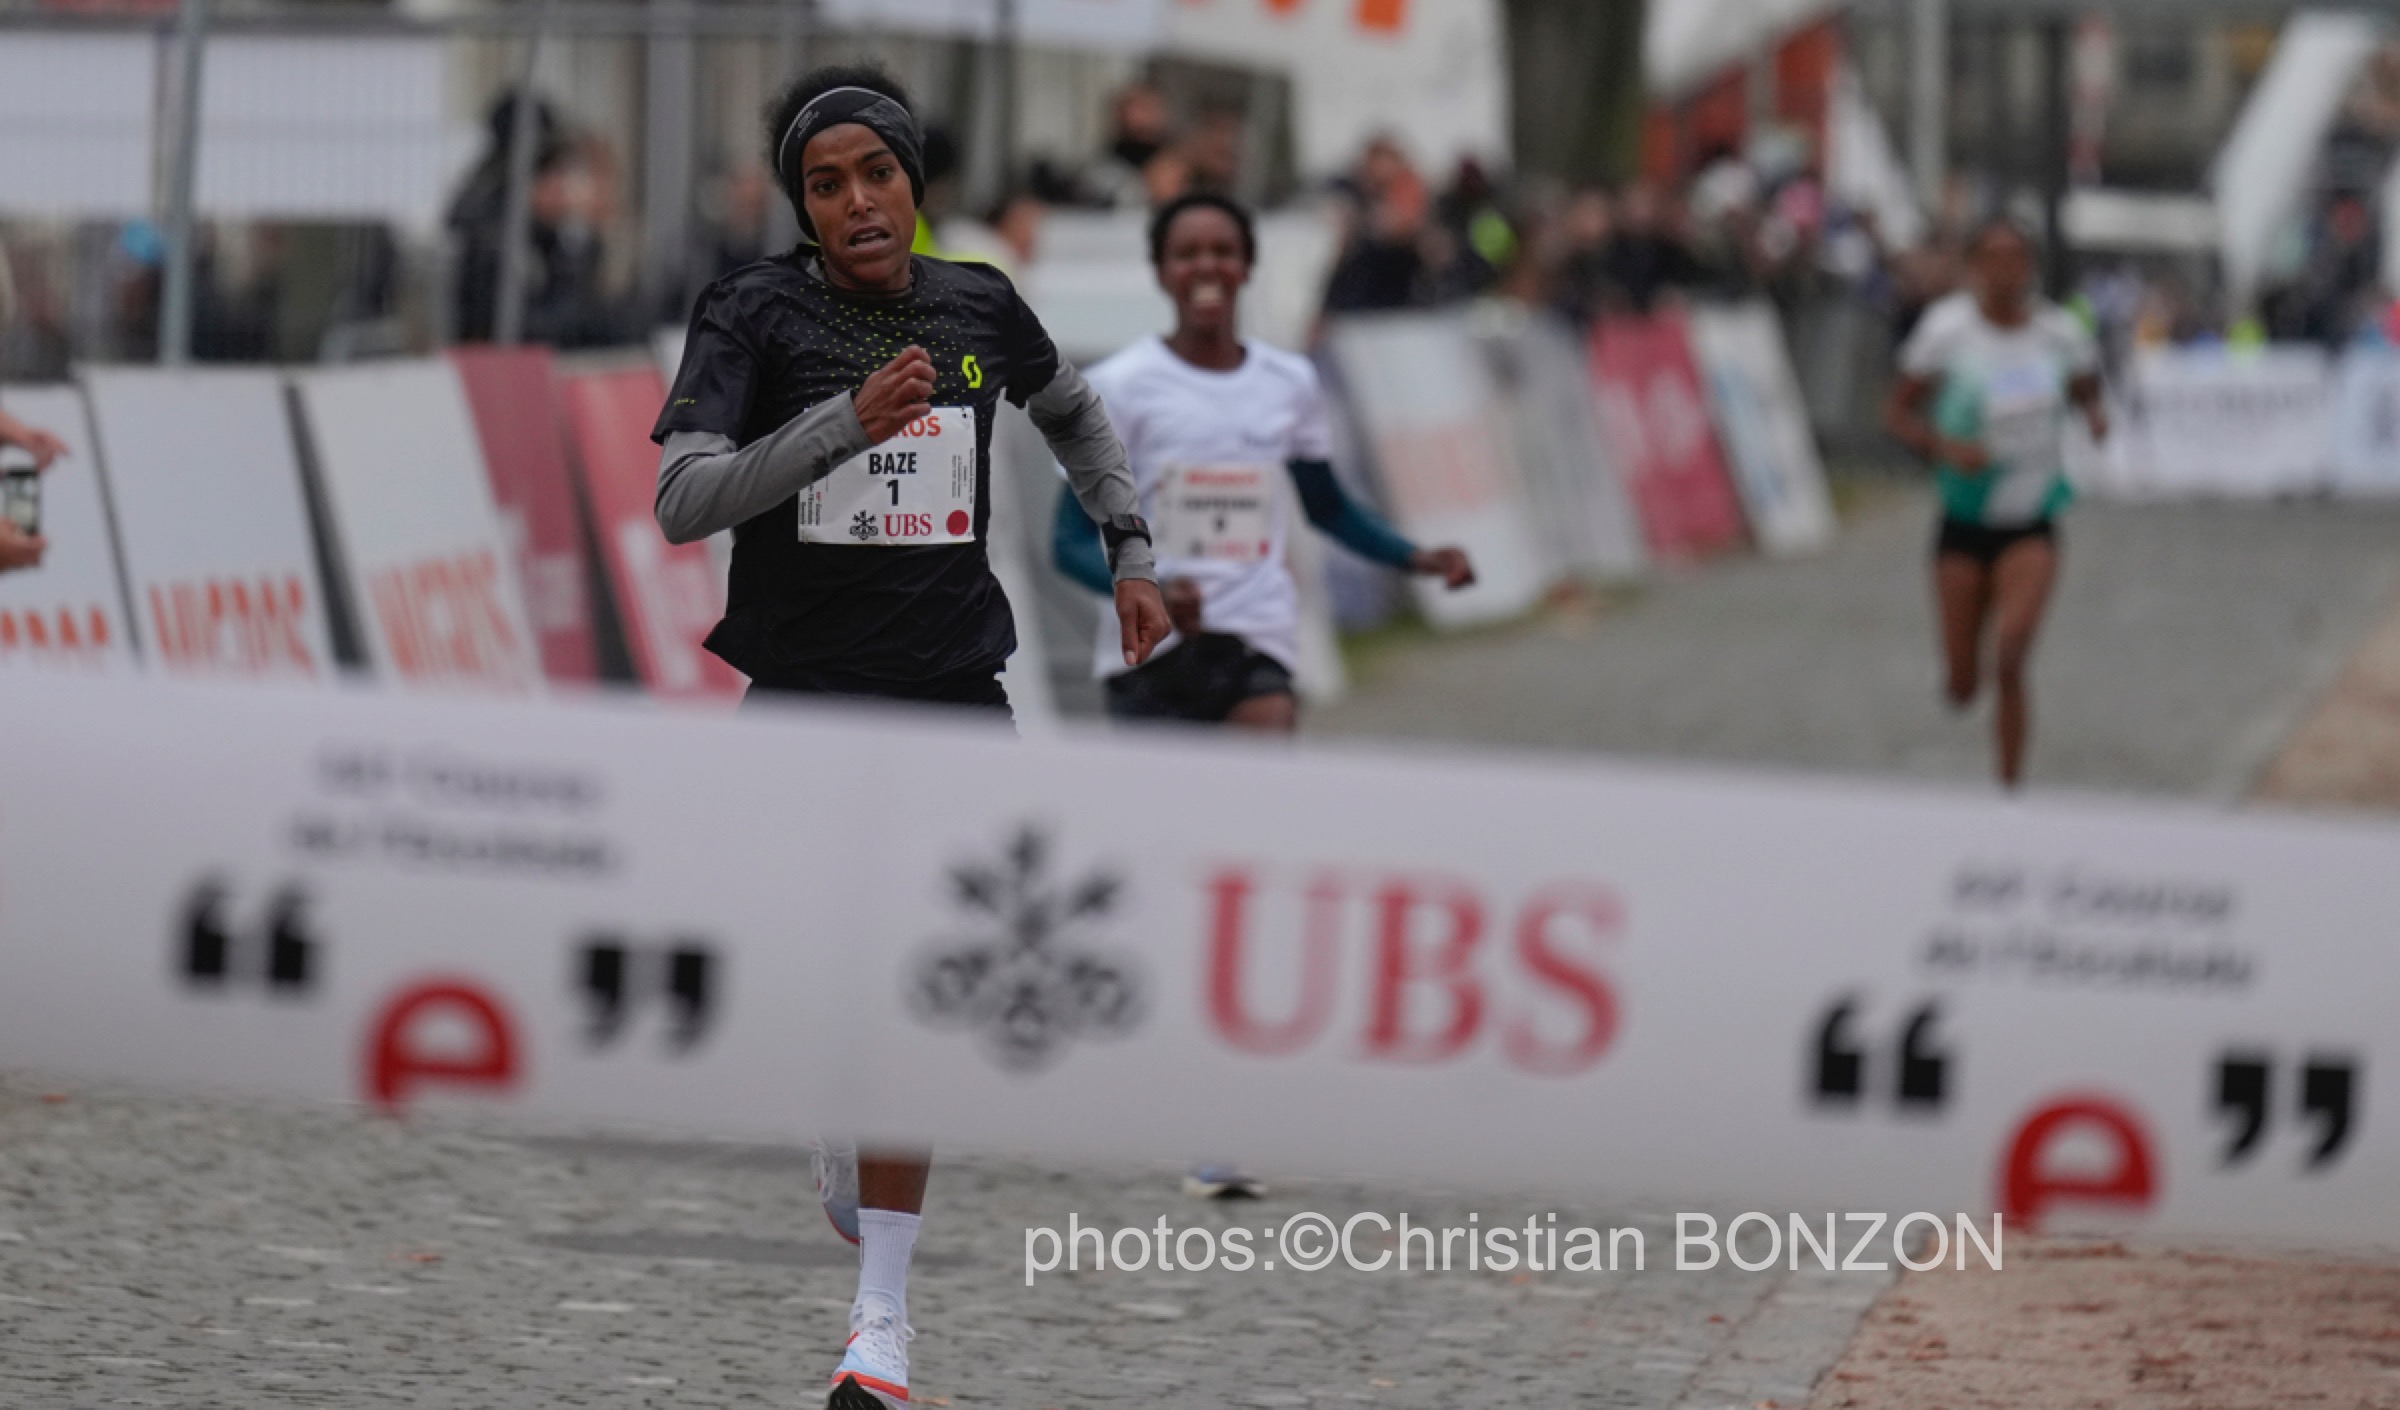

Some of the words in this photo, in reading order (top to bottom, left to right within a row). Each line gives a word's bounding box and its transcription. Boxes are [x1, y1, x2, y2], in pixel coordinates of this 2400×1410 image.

[868, 452, 917, 474] BAZE
[886, 479, 899, 507] 1
[884, 513, 933, 536] UBS
[1197, 858, 1626, 1074] UBS
